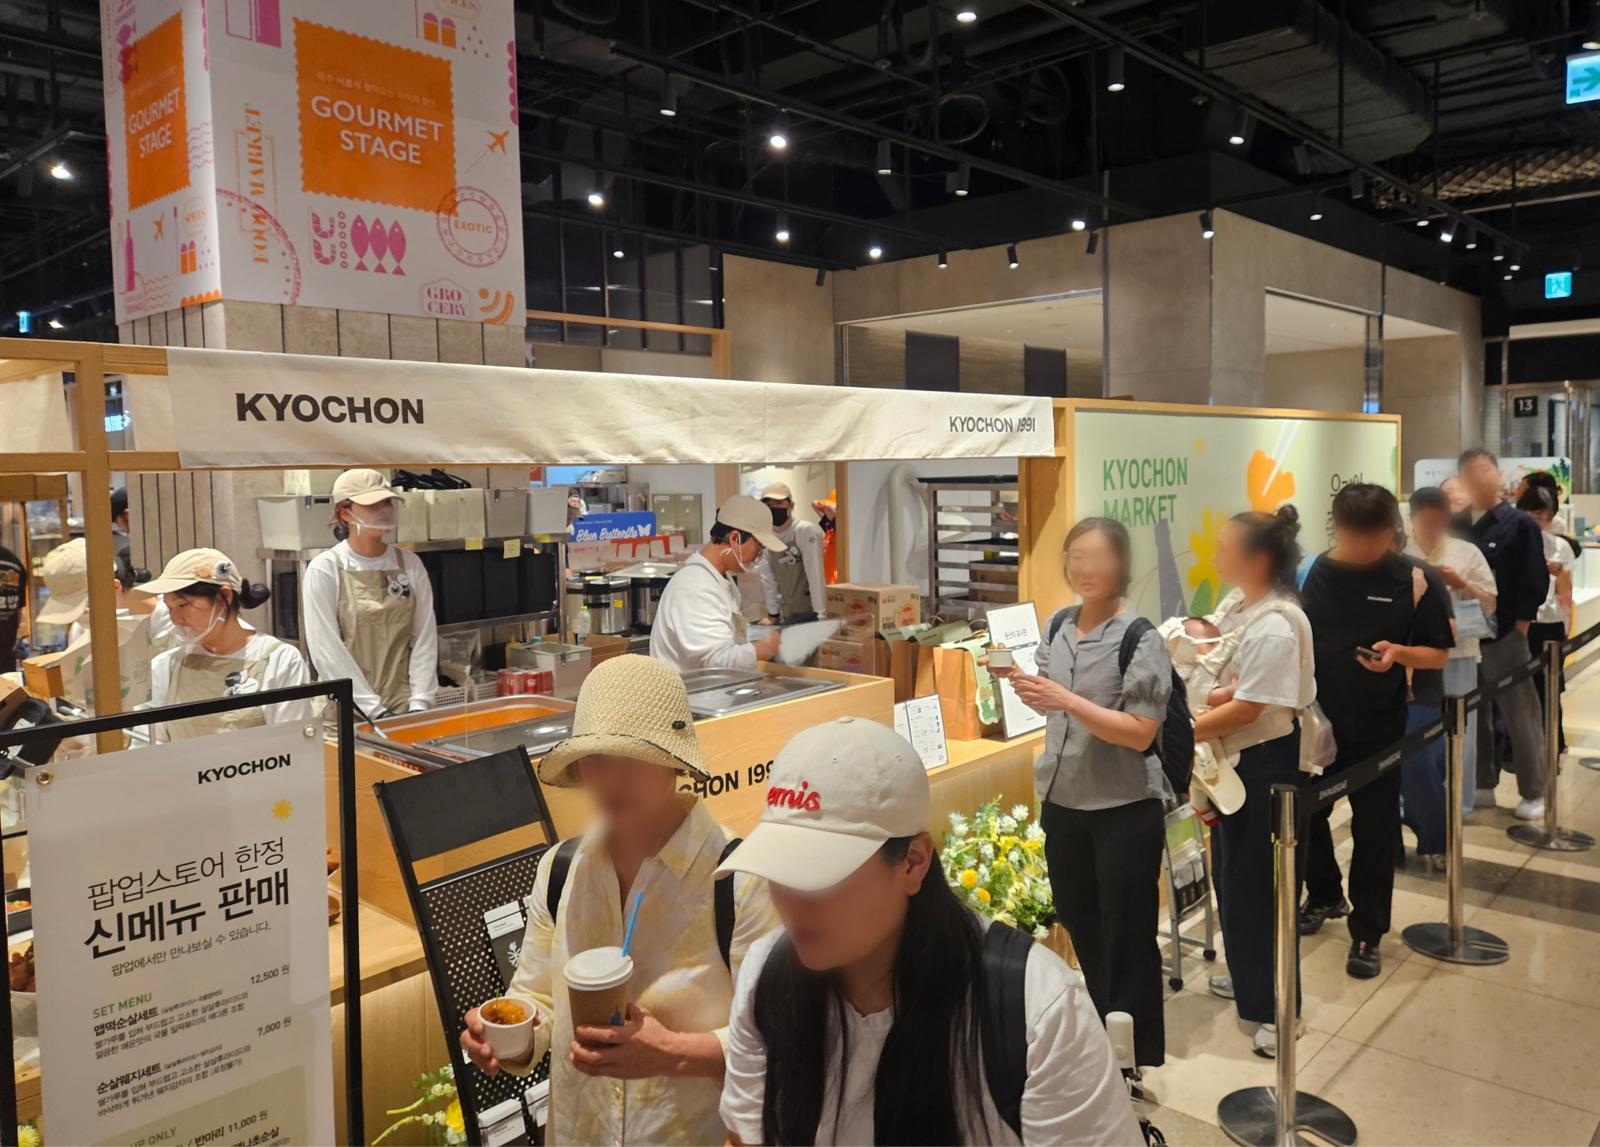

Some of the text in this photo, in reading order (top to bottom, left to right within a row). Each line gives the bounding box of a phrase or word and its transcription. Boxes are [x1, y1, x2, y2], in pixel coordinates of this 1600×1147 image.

[128, 87, 181, 134] GOURMET
[311, 95, 444, 142] GOURMET
[138, 123, 173, 158] STAGE
[244, 103, 266, 197] MARKET
[339, 129, 422, 165] STAGE
[453, 221, 493, 234] EXOTIC
[426, 287, 462, 301] GRO
[235, 392, 424, 424] KYOCHON
[1518, 399, 1533, 412] 13
[949, 416, 1036, 432] KYOCHON 1991
[1103, 457, 1187, 491] KYOCHON
[1103, 494, 1177, 528] MARKET
[198, 753, 291, 785] KYOCHON
[767, 781, 821, 812] emis
[88, 837, 285, 911] 팝업스토어 한정
[84, 868, 290, 959] 신메뉴 판매
[112, 920, 271, 977] 팝업에서만 만나보실 수 있습니다.
[250, 963, 290, 985] 12,500 원
[93, 1004, 115, 1019] SET
[118, 992, 152, 1012] MENU
[94, 1006, 159, 1037] 맵떡순살세트
[257, 1016, 292, 1037] 7,000 원
[97, 1062, 162, 1095] 순살웨지세트
[149, 1126, 177, 1146] ONLY
[228, 1114, 257, 1135] 11,000
[259, 1109, 268, 1121] 원
